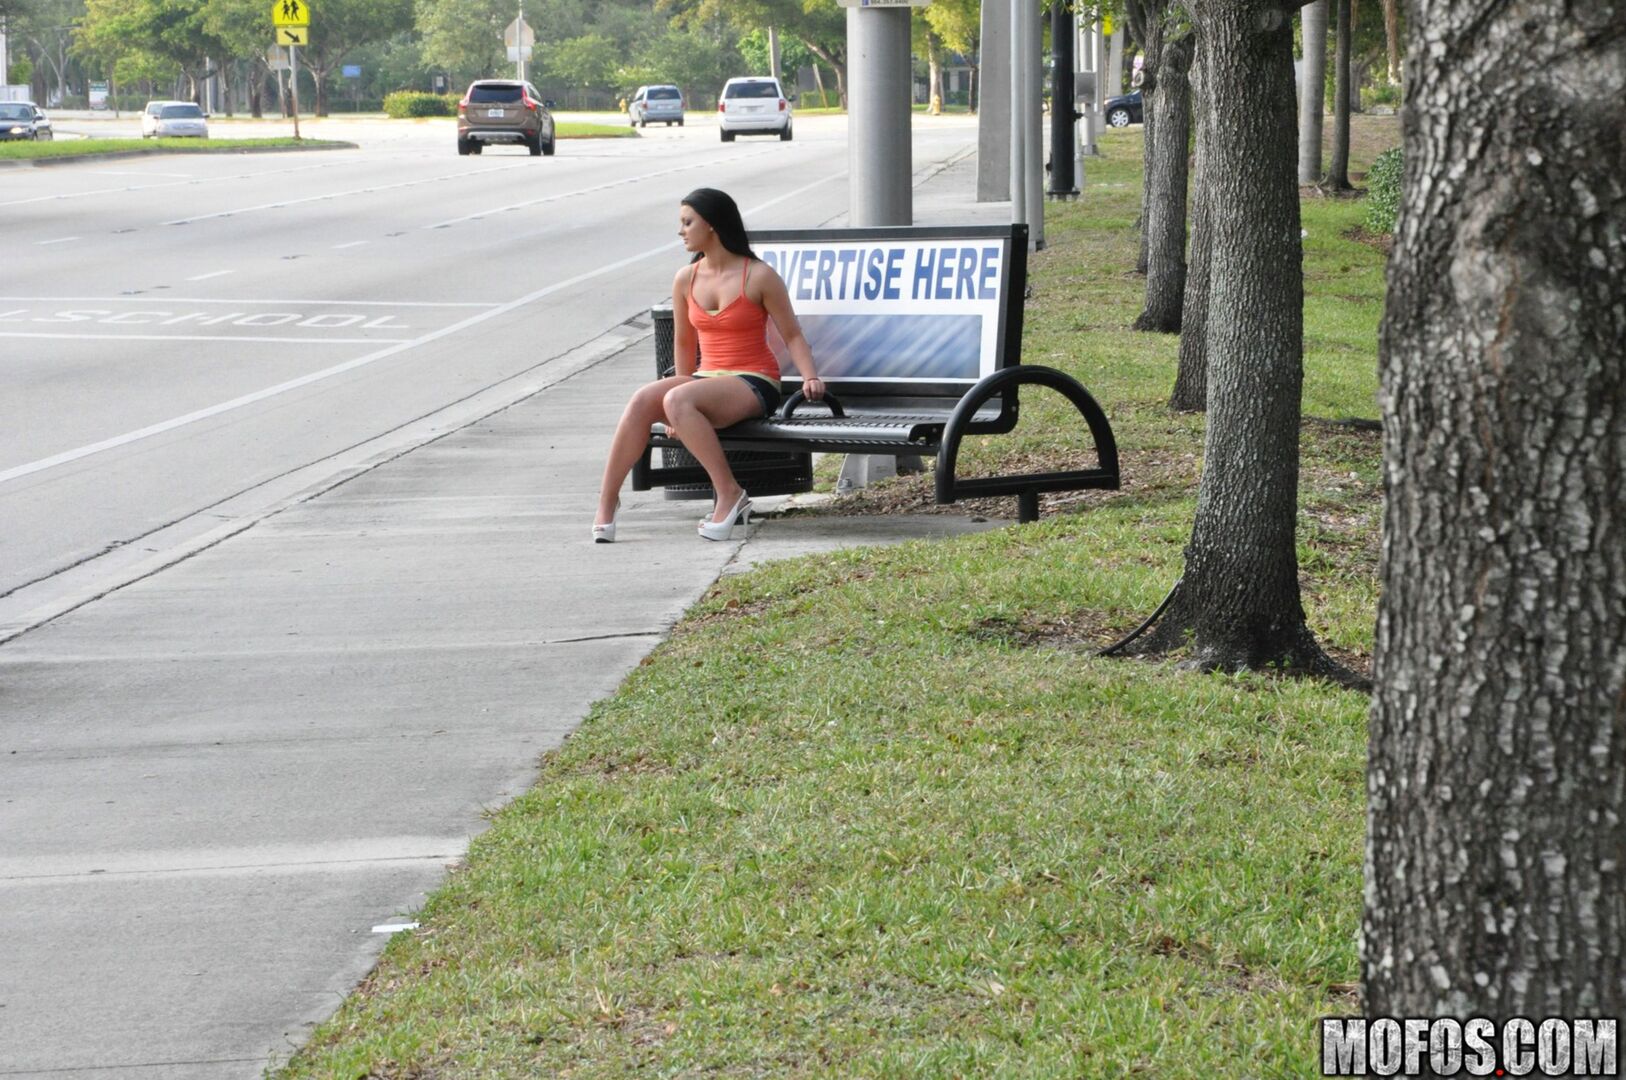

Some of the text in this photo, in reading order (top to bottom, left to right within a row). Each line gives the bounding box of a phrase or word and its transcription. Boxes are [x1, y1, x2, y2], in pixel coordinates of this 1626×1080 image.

[763, 247, 999, 300] VERTISE HERE
[32, 309, 410, 328] SCHOOL
